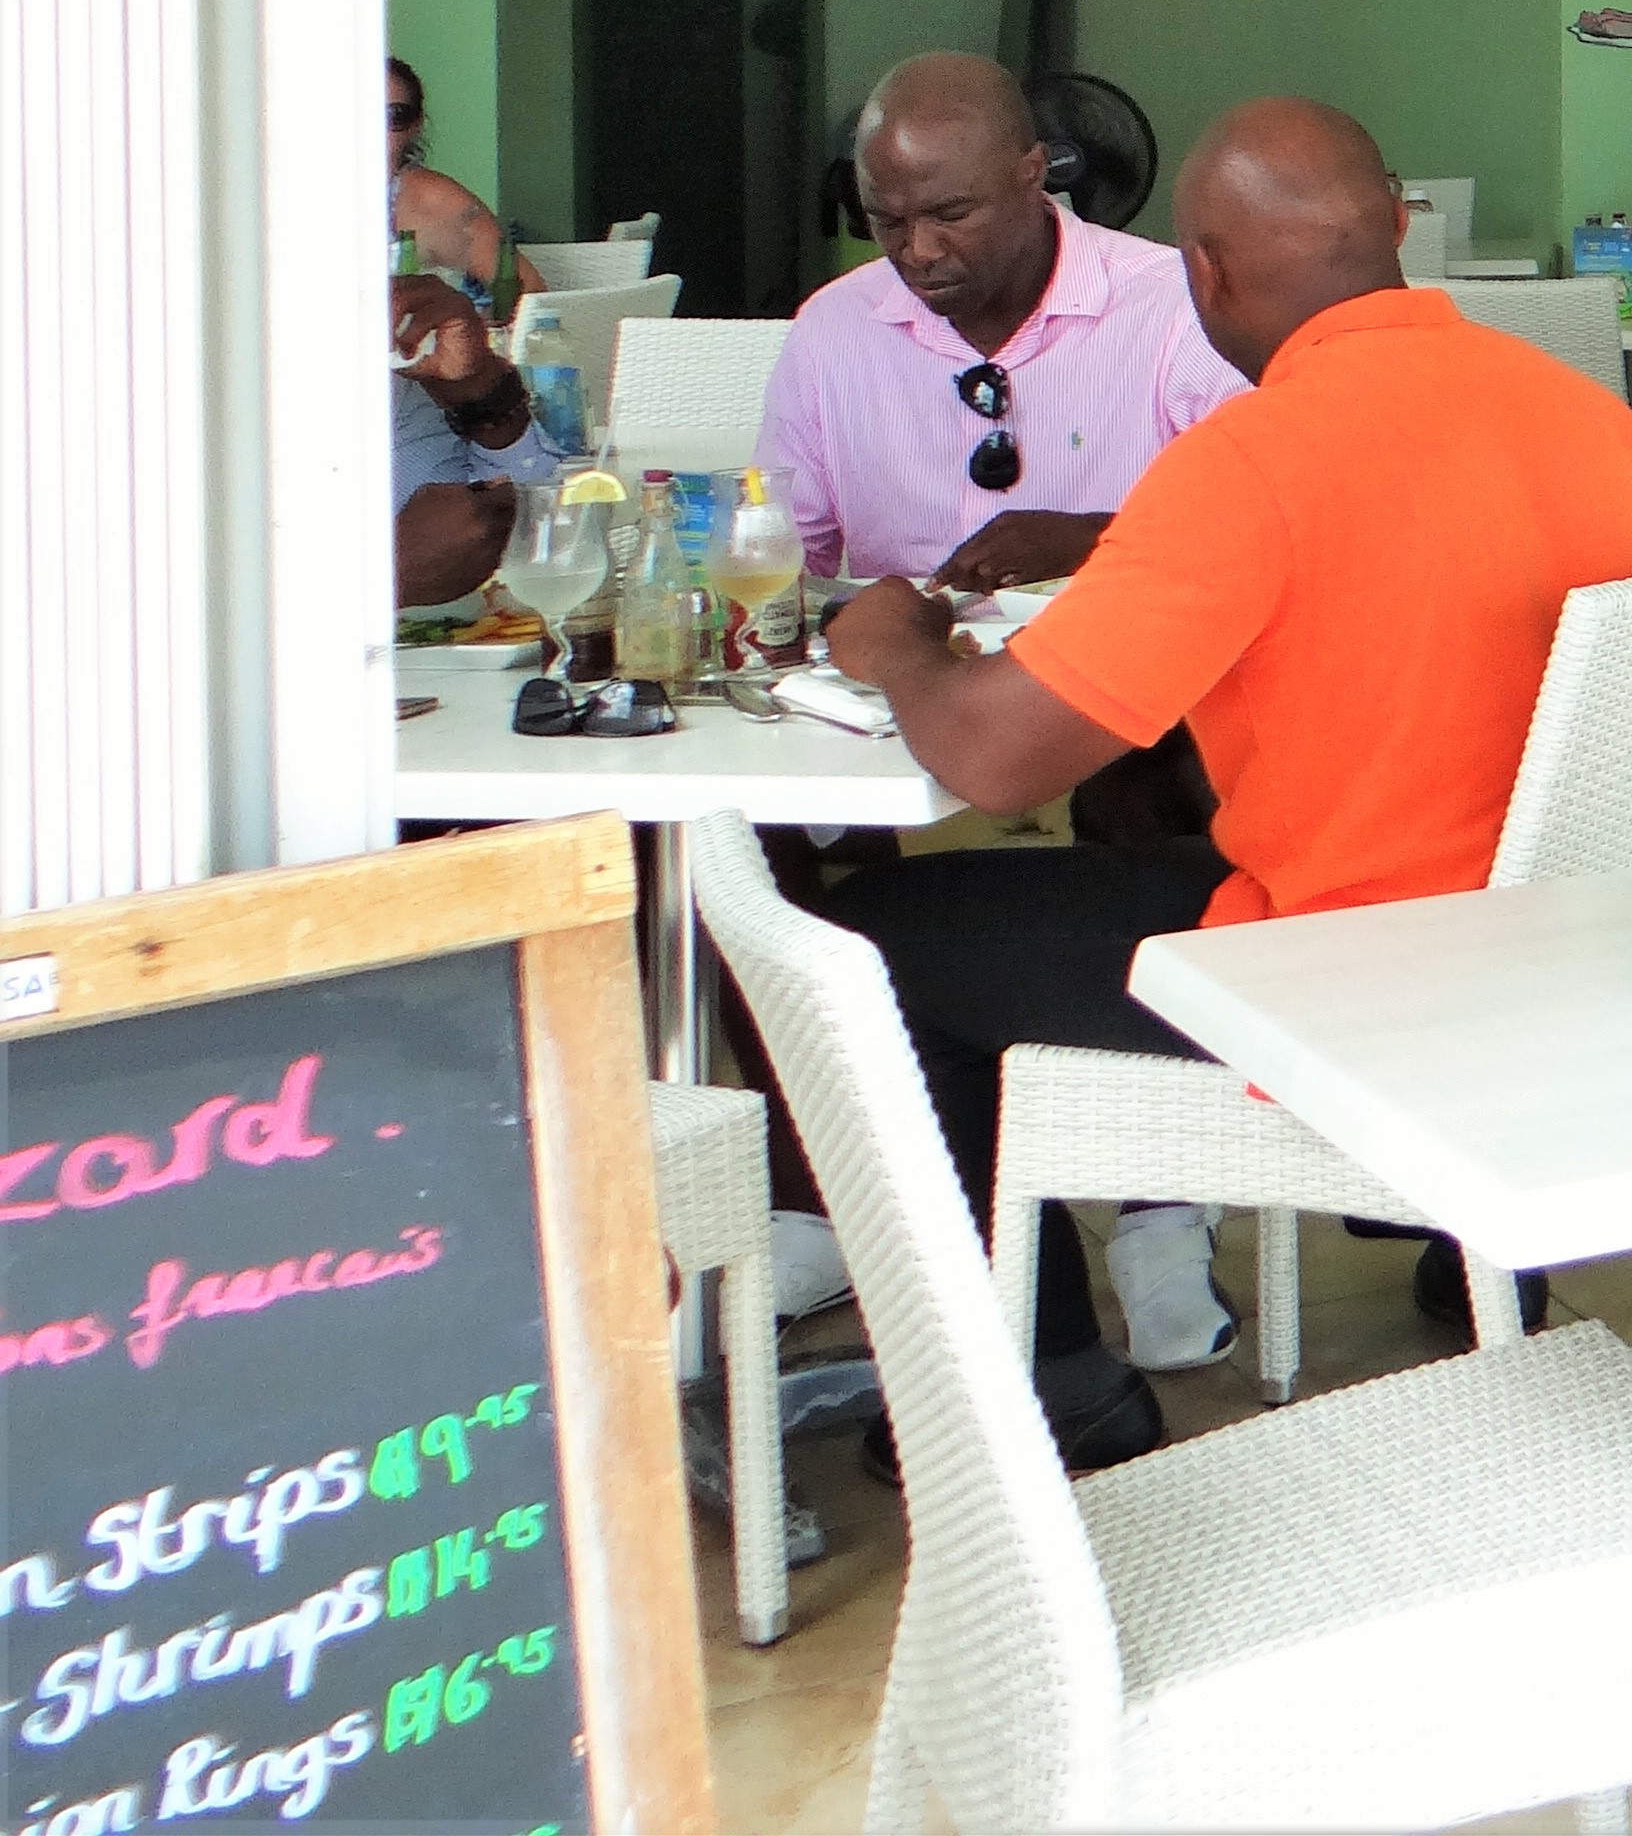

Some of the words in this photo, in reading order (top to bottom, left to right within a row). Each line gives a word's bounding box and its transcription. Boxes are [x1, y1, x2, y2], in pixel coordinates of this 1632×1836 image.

[84, 1447, 367, 1592] Strips
[22, 1566, 384, 1746] Shrimps
[155, 1710, 378, 1821] Rings
